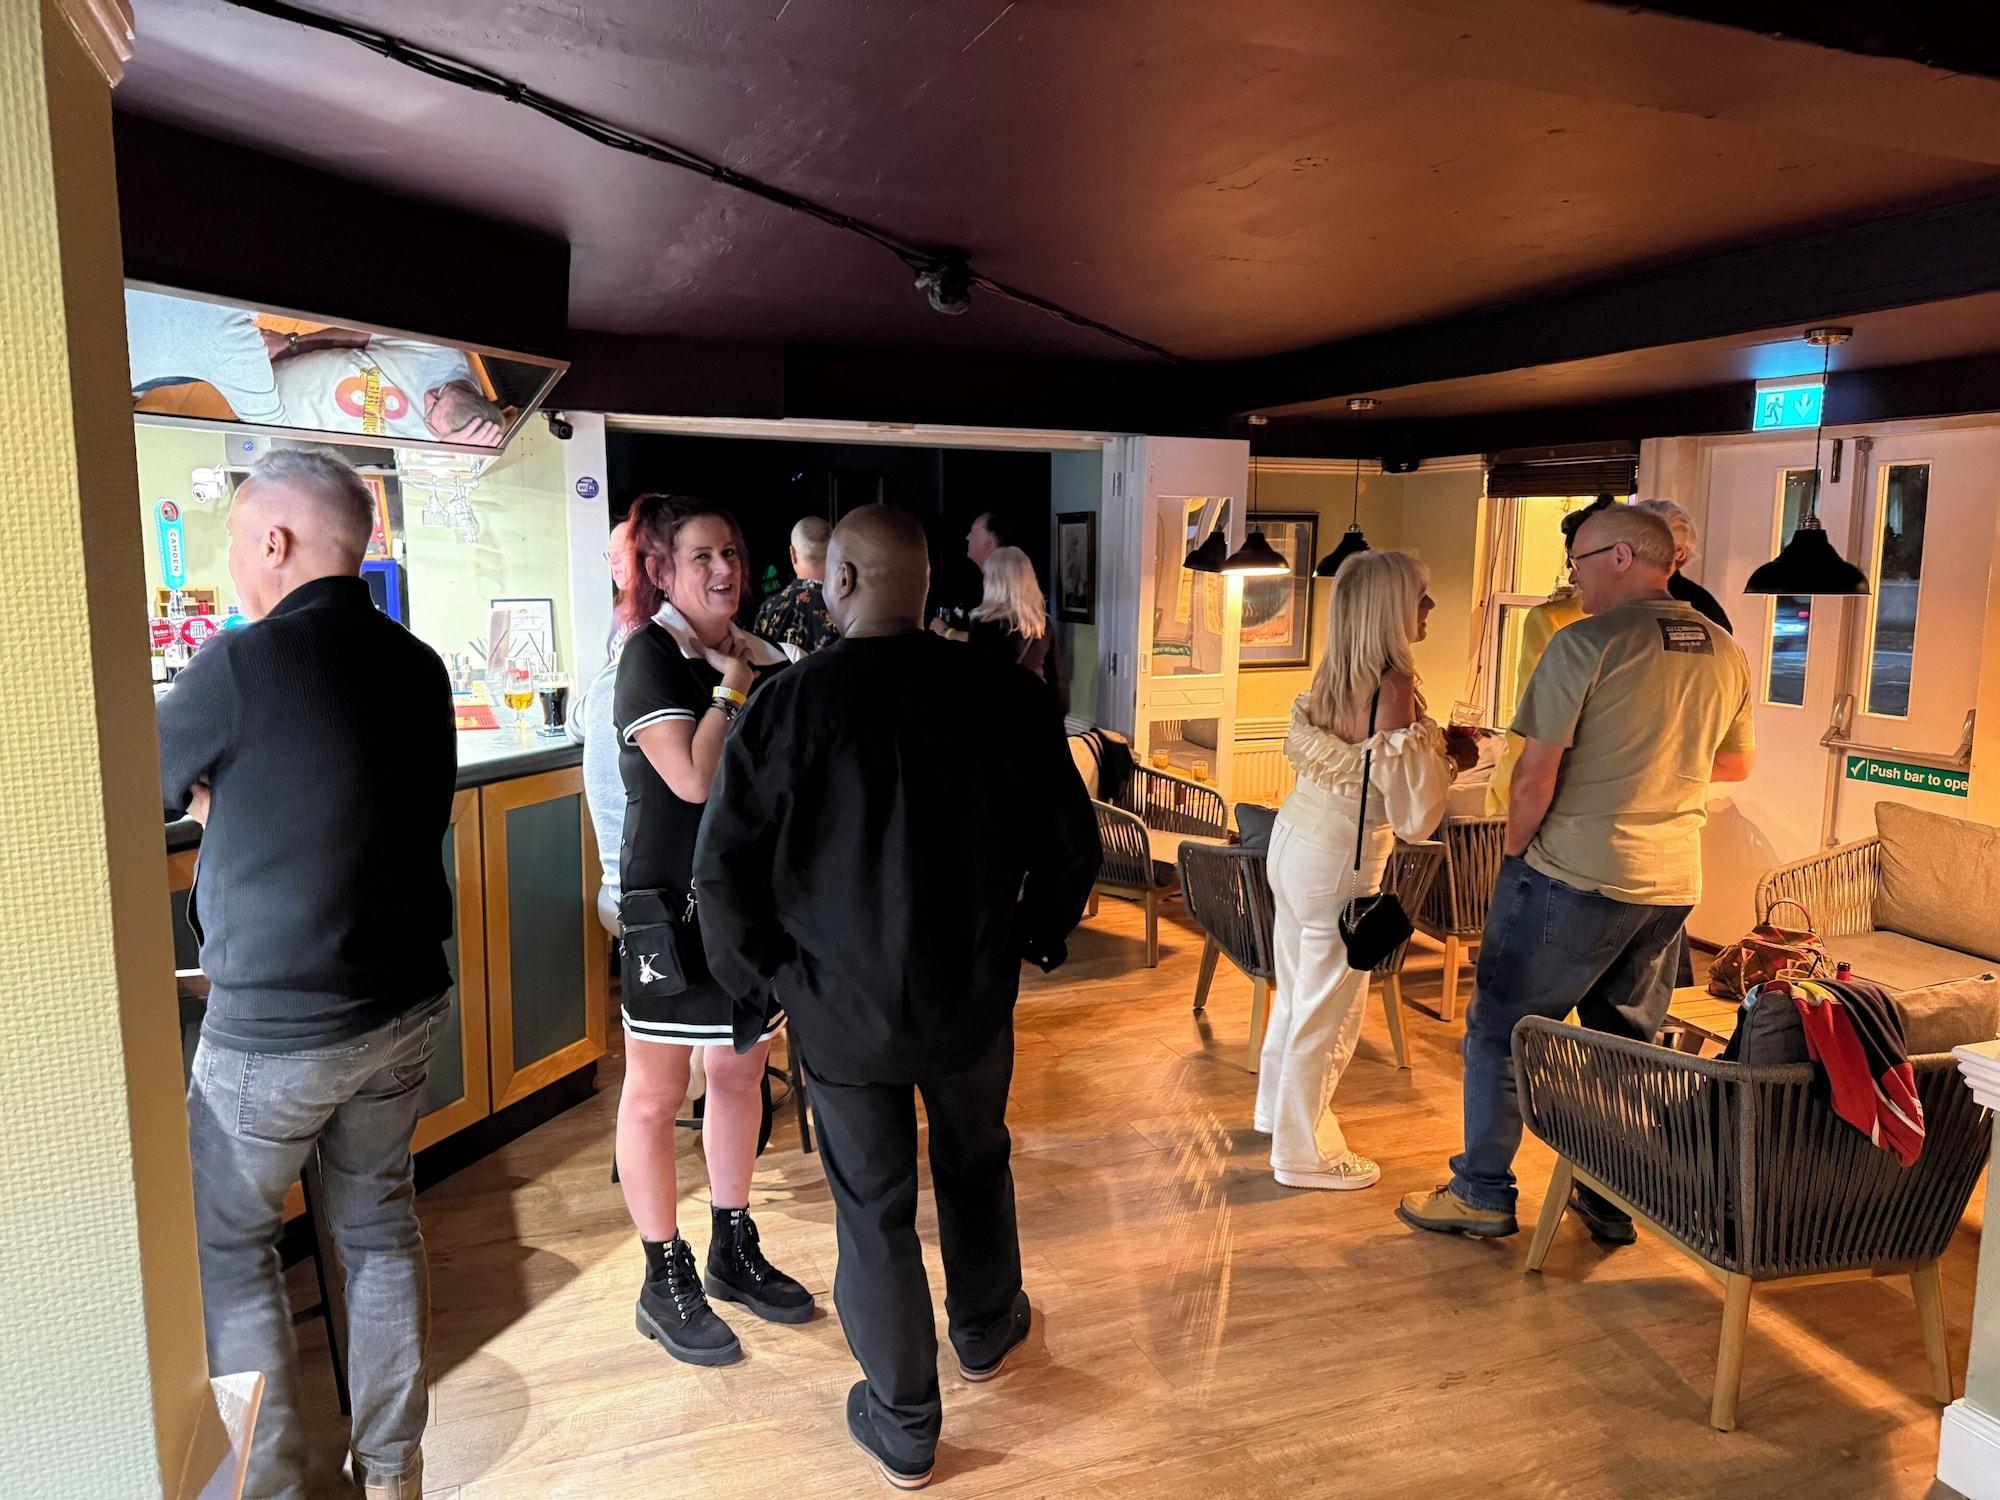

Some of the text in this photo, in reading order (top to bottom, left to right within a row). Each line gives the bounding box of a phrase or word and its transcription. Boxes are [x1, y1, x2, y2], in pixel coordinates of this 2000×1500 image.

[170, 532, 179, 572] CAMDEN
[1870, 764, 1900, 779] Push
[1903, 769, 1925, 783] bar
[1928, 775, 1941, 786] to
[638, 953, 668, 985] K
